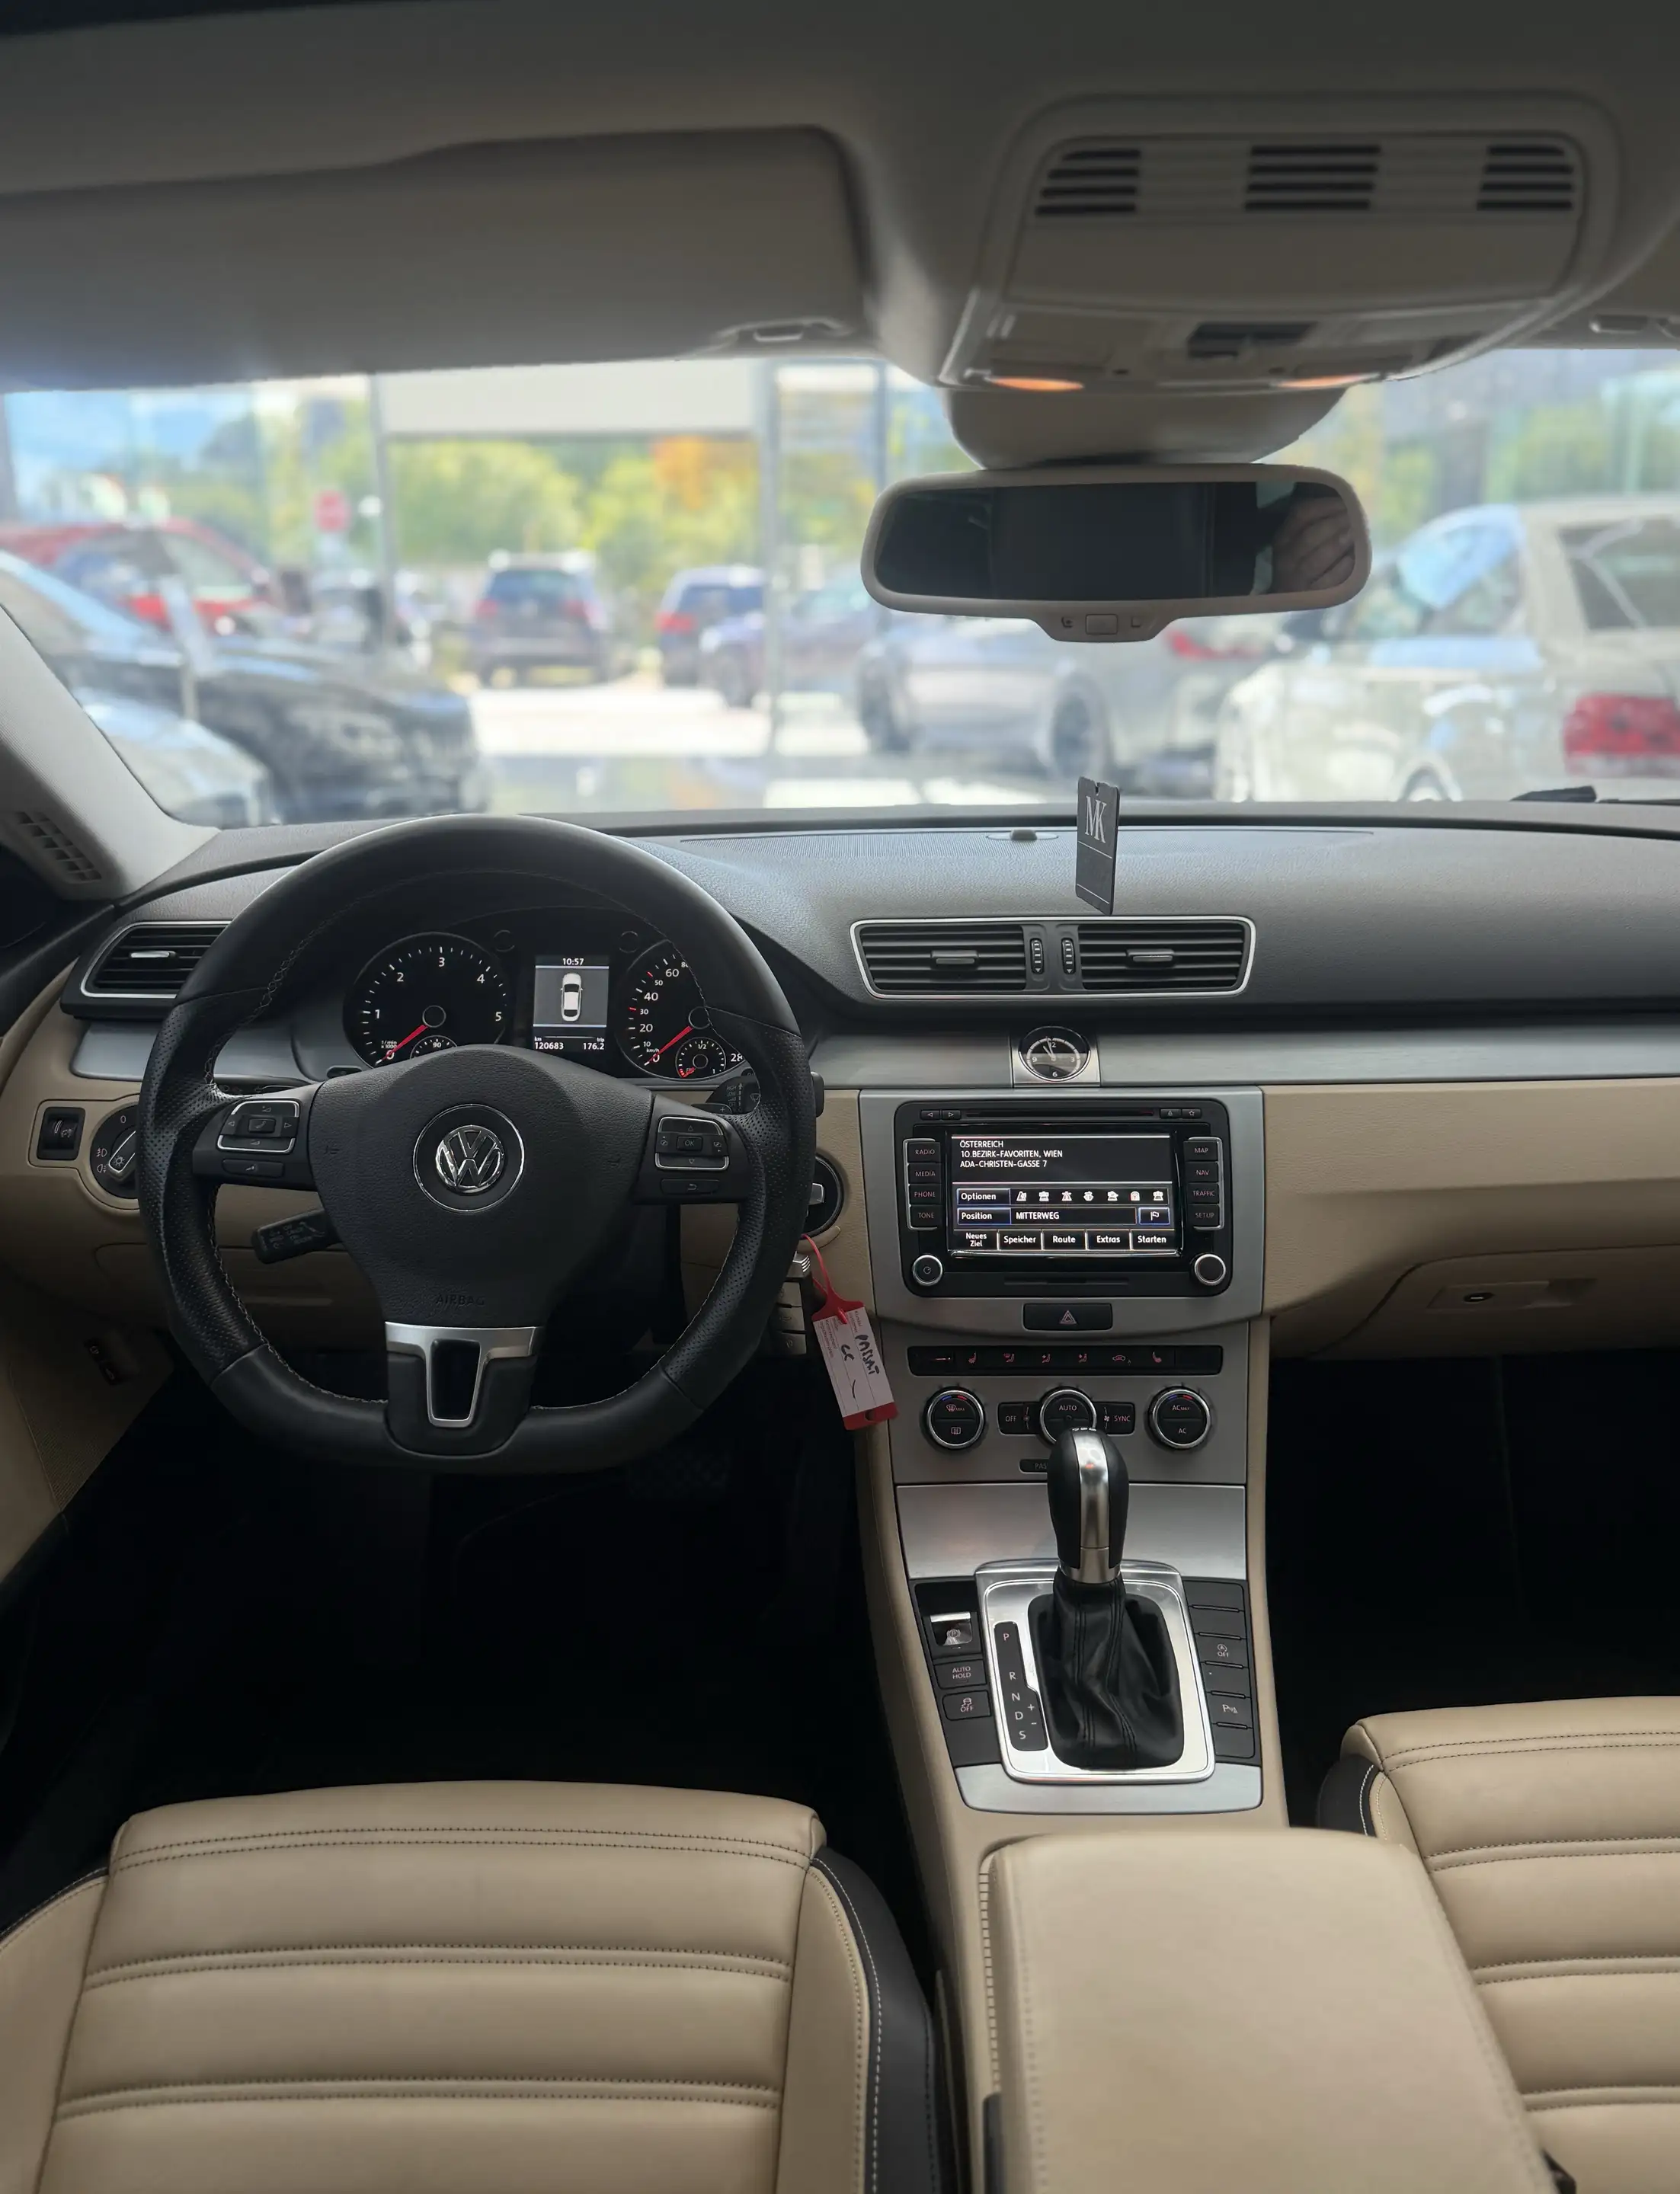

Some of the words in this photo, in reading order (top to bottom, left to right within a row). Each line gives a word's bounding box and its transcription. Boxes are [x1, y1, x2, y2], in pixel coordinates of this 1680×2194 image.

[438, 957, 445, 967] 3
[397, 972, 404, 982] 2
[665, 968, 680, 977] 60
[477, 974, 485, 983] 4
[644, 992, 659, 1001] 40
[375, 1009, 380, 1019] 1
[495, 1012, 502, 1022] 5
[639, 1023, 653, 1032] 20
[959, 1140, 1004, 1148] ÖSTERREICH
[961, 1192, 997, 1201] Optionen
[961, 1211, 993, 1220] Position
[1016, 1211, 1060, 1220] MITTERWEG
[1003, 1236, 1036, 1245] Speicher
[1052, 1235, 1076, 1243] Route
[1096, 1235, 1121, 1243] Extras
[1138, 1235, 1166, 1243] Starten
[436, 1294, 485, 1306] AIRBAG
[855, 1334, 879, 1375] PASSAT
[1003, 1633, 1010, 1641] P
[1009, 1671, 1017, 1681] R
[1012, 1693, 1020, 1701] N
[1015, 1711, 1023, 1720] D
[1019, 1730, 1026, 1739] S
